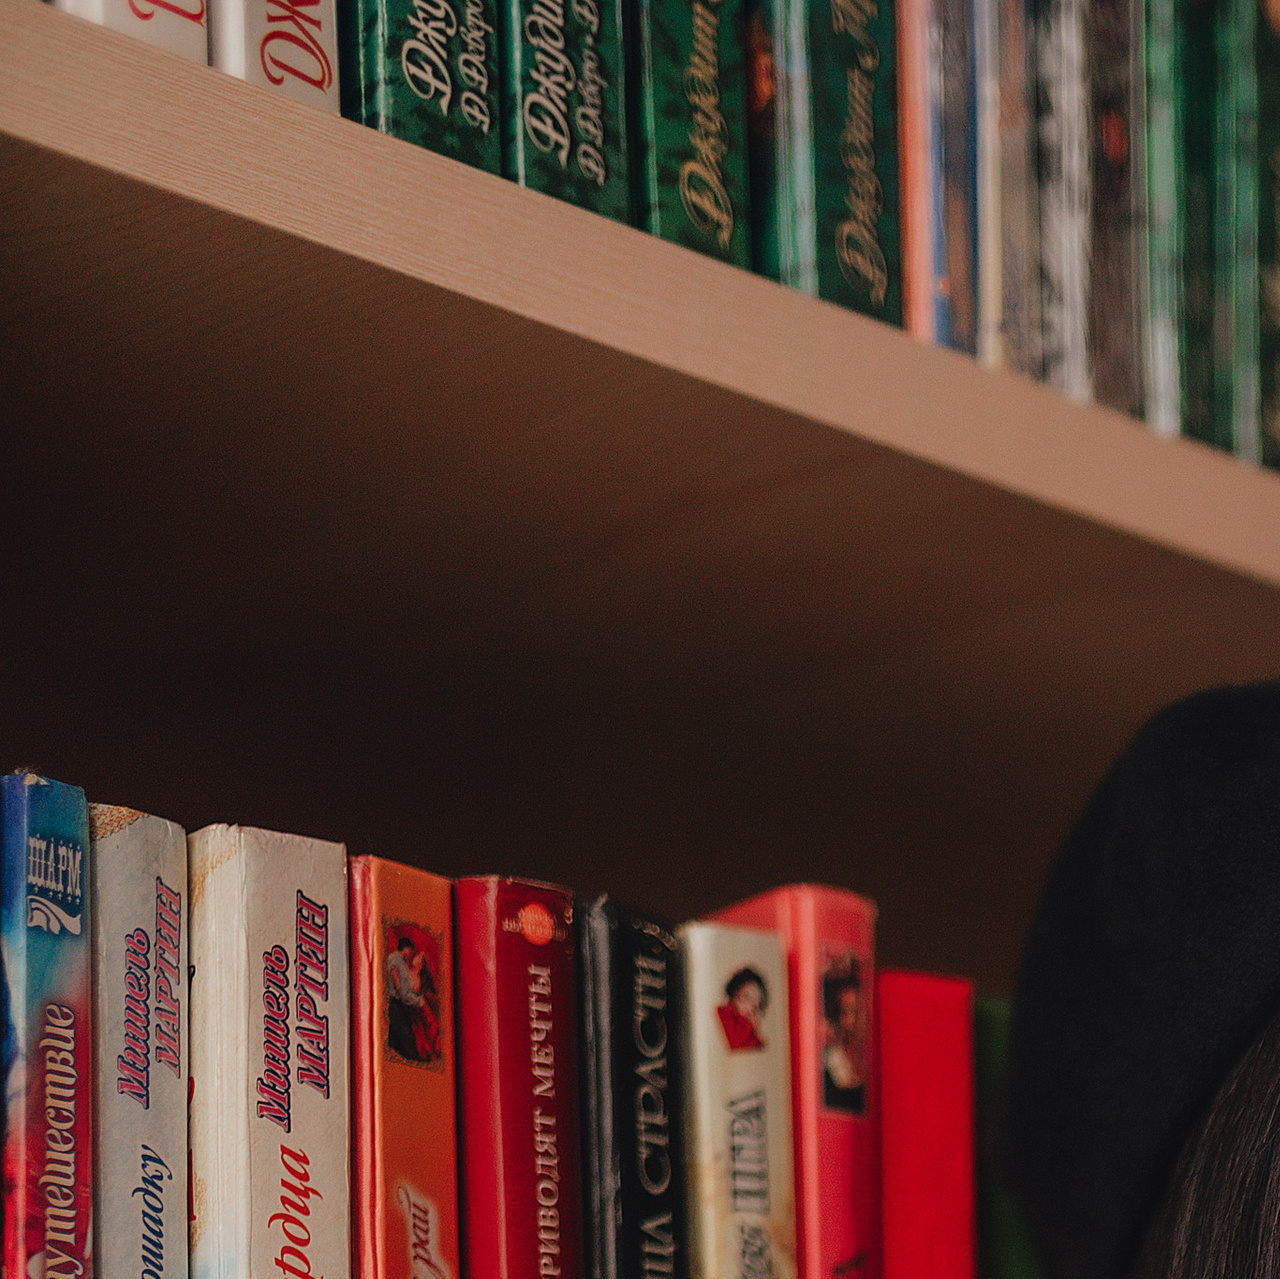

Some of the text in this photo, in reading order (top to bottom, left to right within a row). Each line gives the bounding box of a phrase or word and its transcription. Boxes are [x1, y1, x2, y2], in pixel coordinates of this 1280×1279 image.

[27, 833, 83, 904] ШАРМ
[117, 927, 151, 1110] Мишель
[155, 876, 183, 1080] МАРТИН
[256, 944, 292, 1134] Мишель
[294, 888, 330, 1100] МАРТИН
[527, 963, 557, 1099] МЕЧТЫ
[633, 952, 673, 1196] СТРАСТИ
